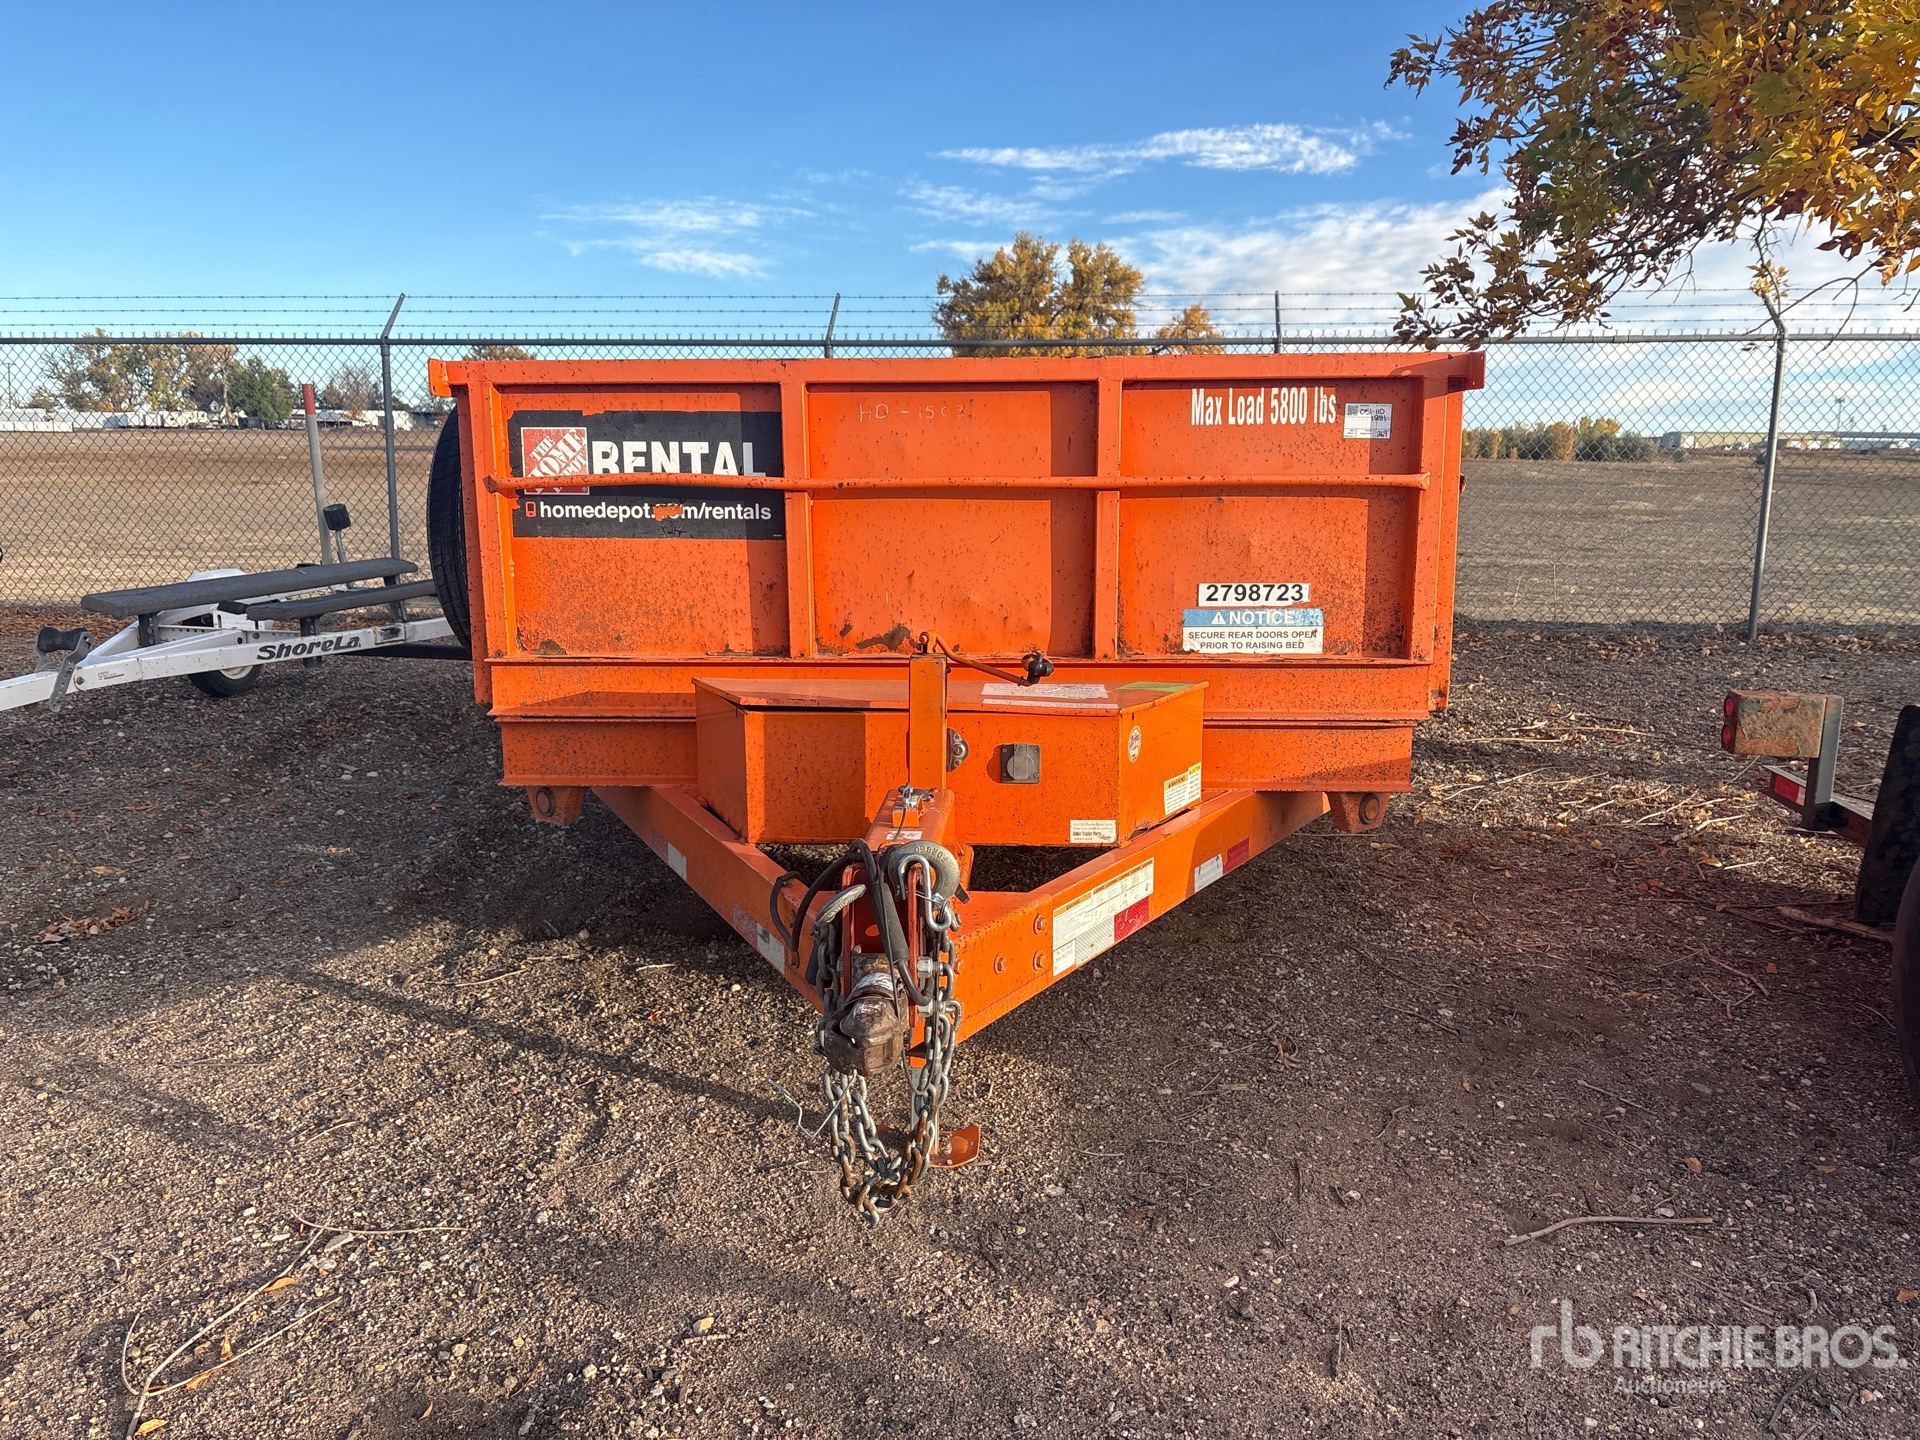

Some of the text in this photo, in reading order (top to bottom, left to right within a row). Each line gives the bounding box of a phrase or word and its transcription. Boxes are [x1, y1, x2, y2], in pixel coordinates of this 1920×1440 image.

[860, 403, 888, 422] HD
[1191, 386, 1336, 425] Max Load 5800 lbs
[530, 435, 555, 461] THE
[592, 441, 766, 477] RENTAL
[1206, 584, 1304, 602] 2798723
[1229, 610, 1296, 625] NOTICE
[1188, 631, 1317, 639] SECURE REAR DOORS OPEN
[1285, 641, 1305, 649] BED
[914, 845, 949, 863] FORGED
